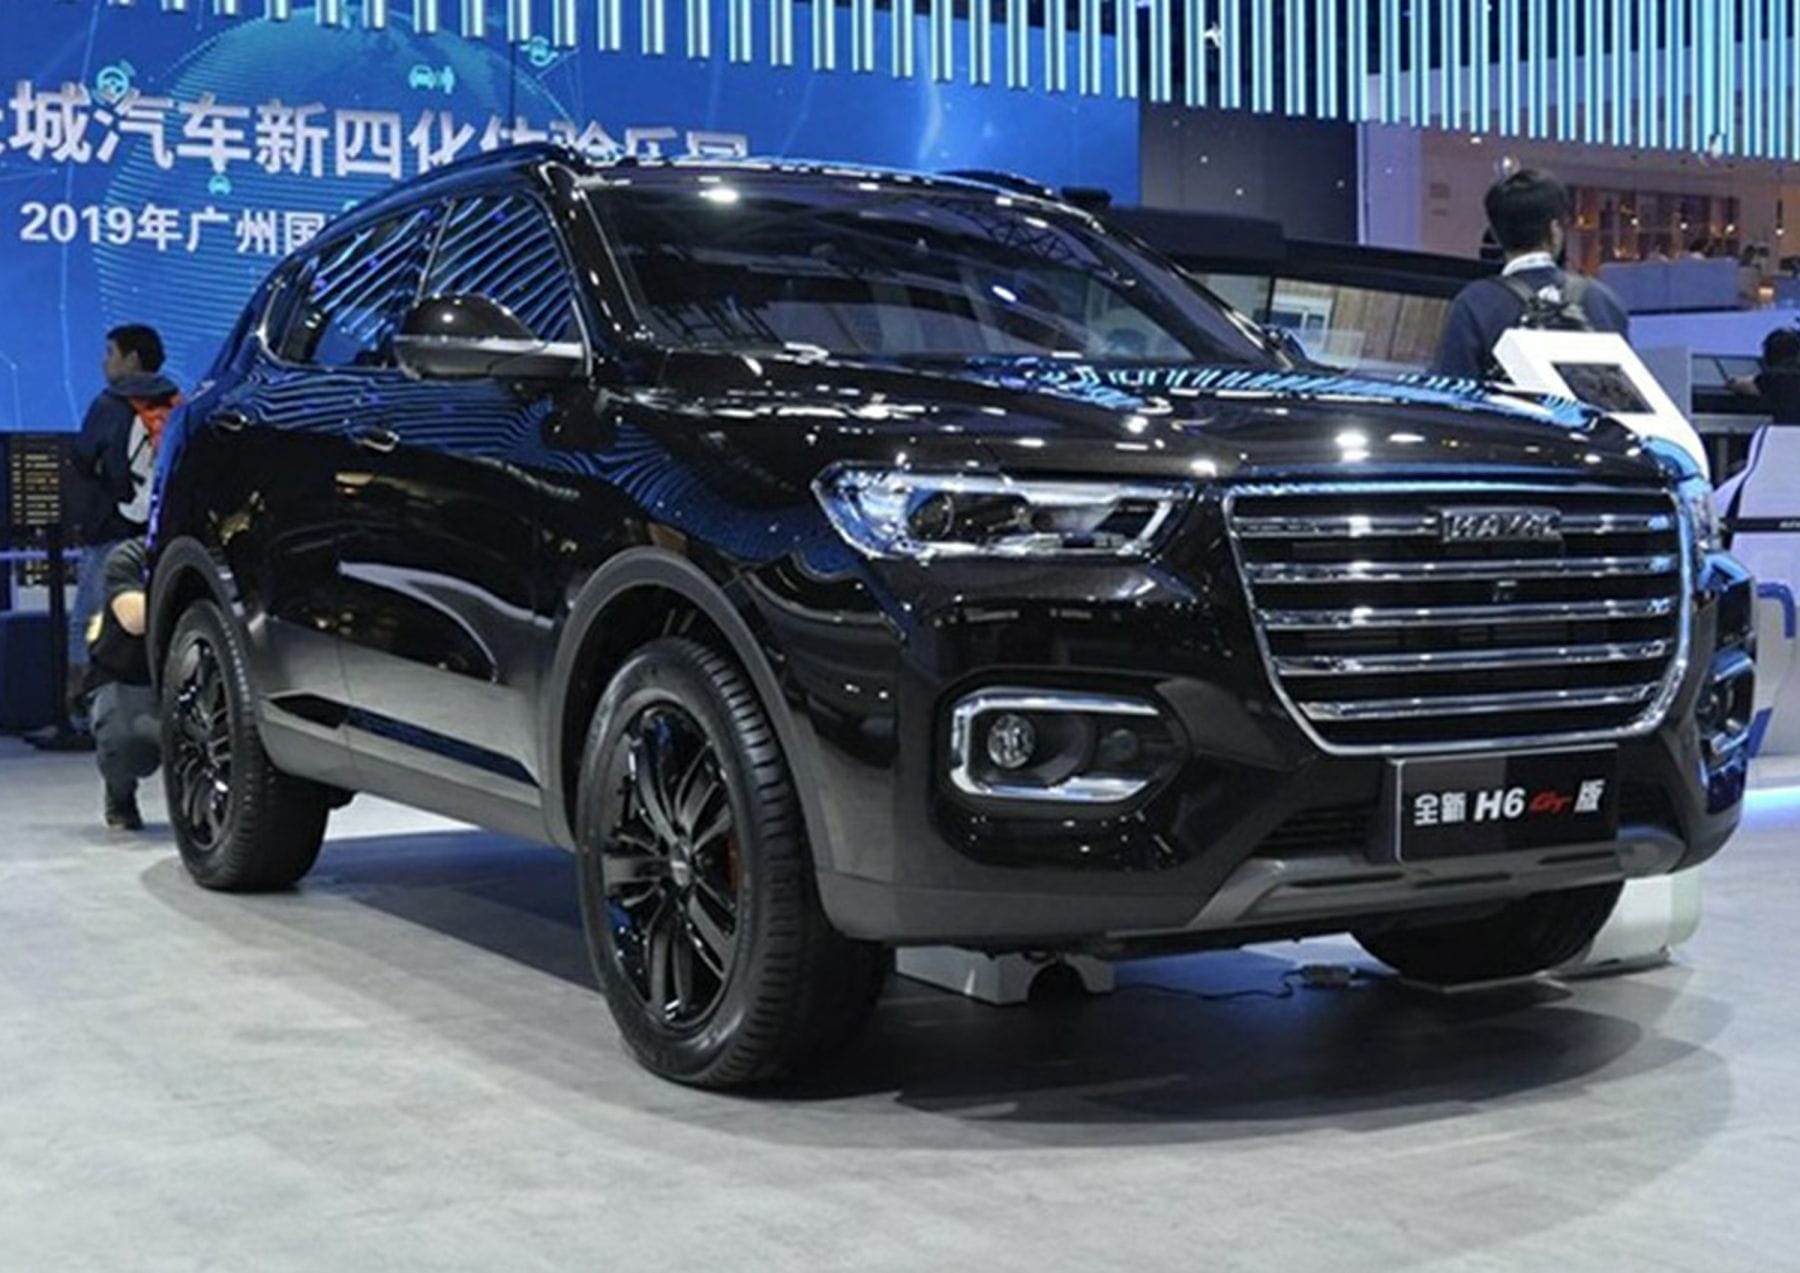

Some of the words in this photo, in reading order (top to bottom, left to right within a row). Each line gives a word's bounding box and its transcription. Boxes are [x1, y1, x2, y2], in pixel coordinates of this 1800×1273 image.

[20, 203, 336, 256] 2019年广州国
[1414, 792, 1467, 826] 全新
[1474, 787, 1525, 821] H6
